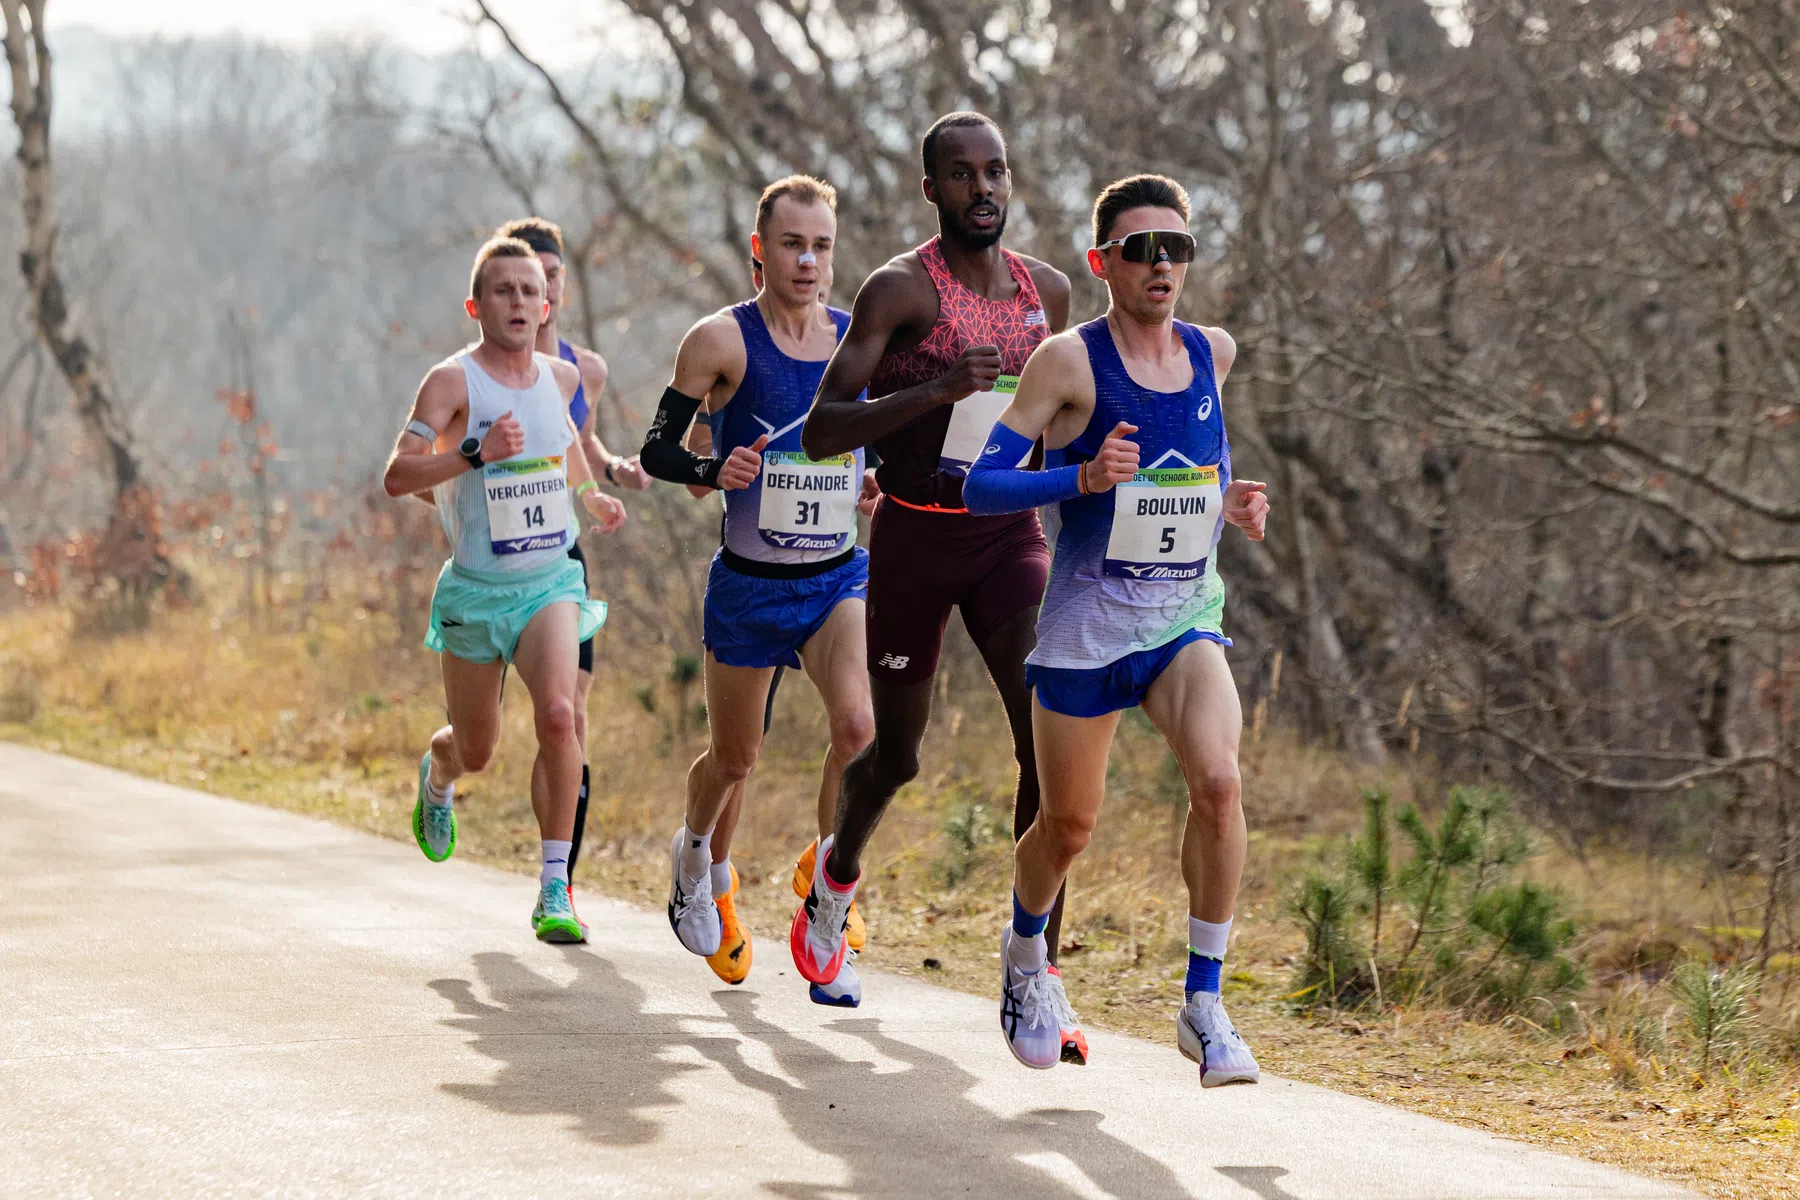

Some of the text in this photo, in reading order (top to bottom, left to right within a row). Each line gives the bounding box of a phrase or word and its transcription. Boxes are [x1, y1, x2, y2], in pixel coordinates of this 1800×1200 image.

[996, 379, 1018, 389] SCHOO
[767, 472, 849, 491] DEFLANDRE
[1133, 470, 1215, 482] OET UIT SCHOORL RUN 2026
[488, 478, 565, 501] VERCAUTEREN
[523, 505, 545, 528] 14
[795, 501, 820, 525] 31
[1137, 496, 1206, 516] BOULVIN
[1159, 527, 1176, 553] 5
